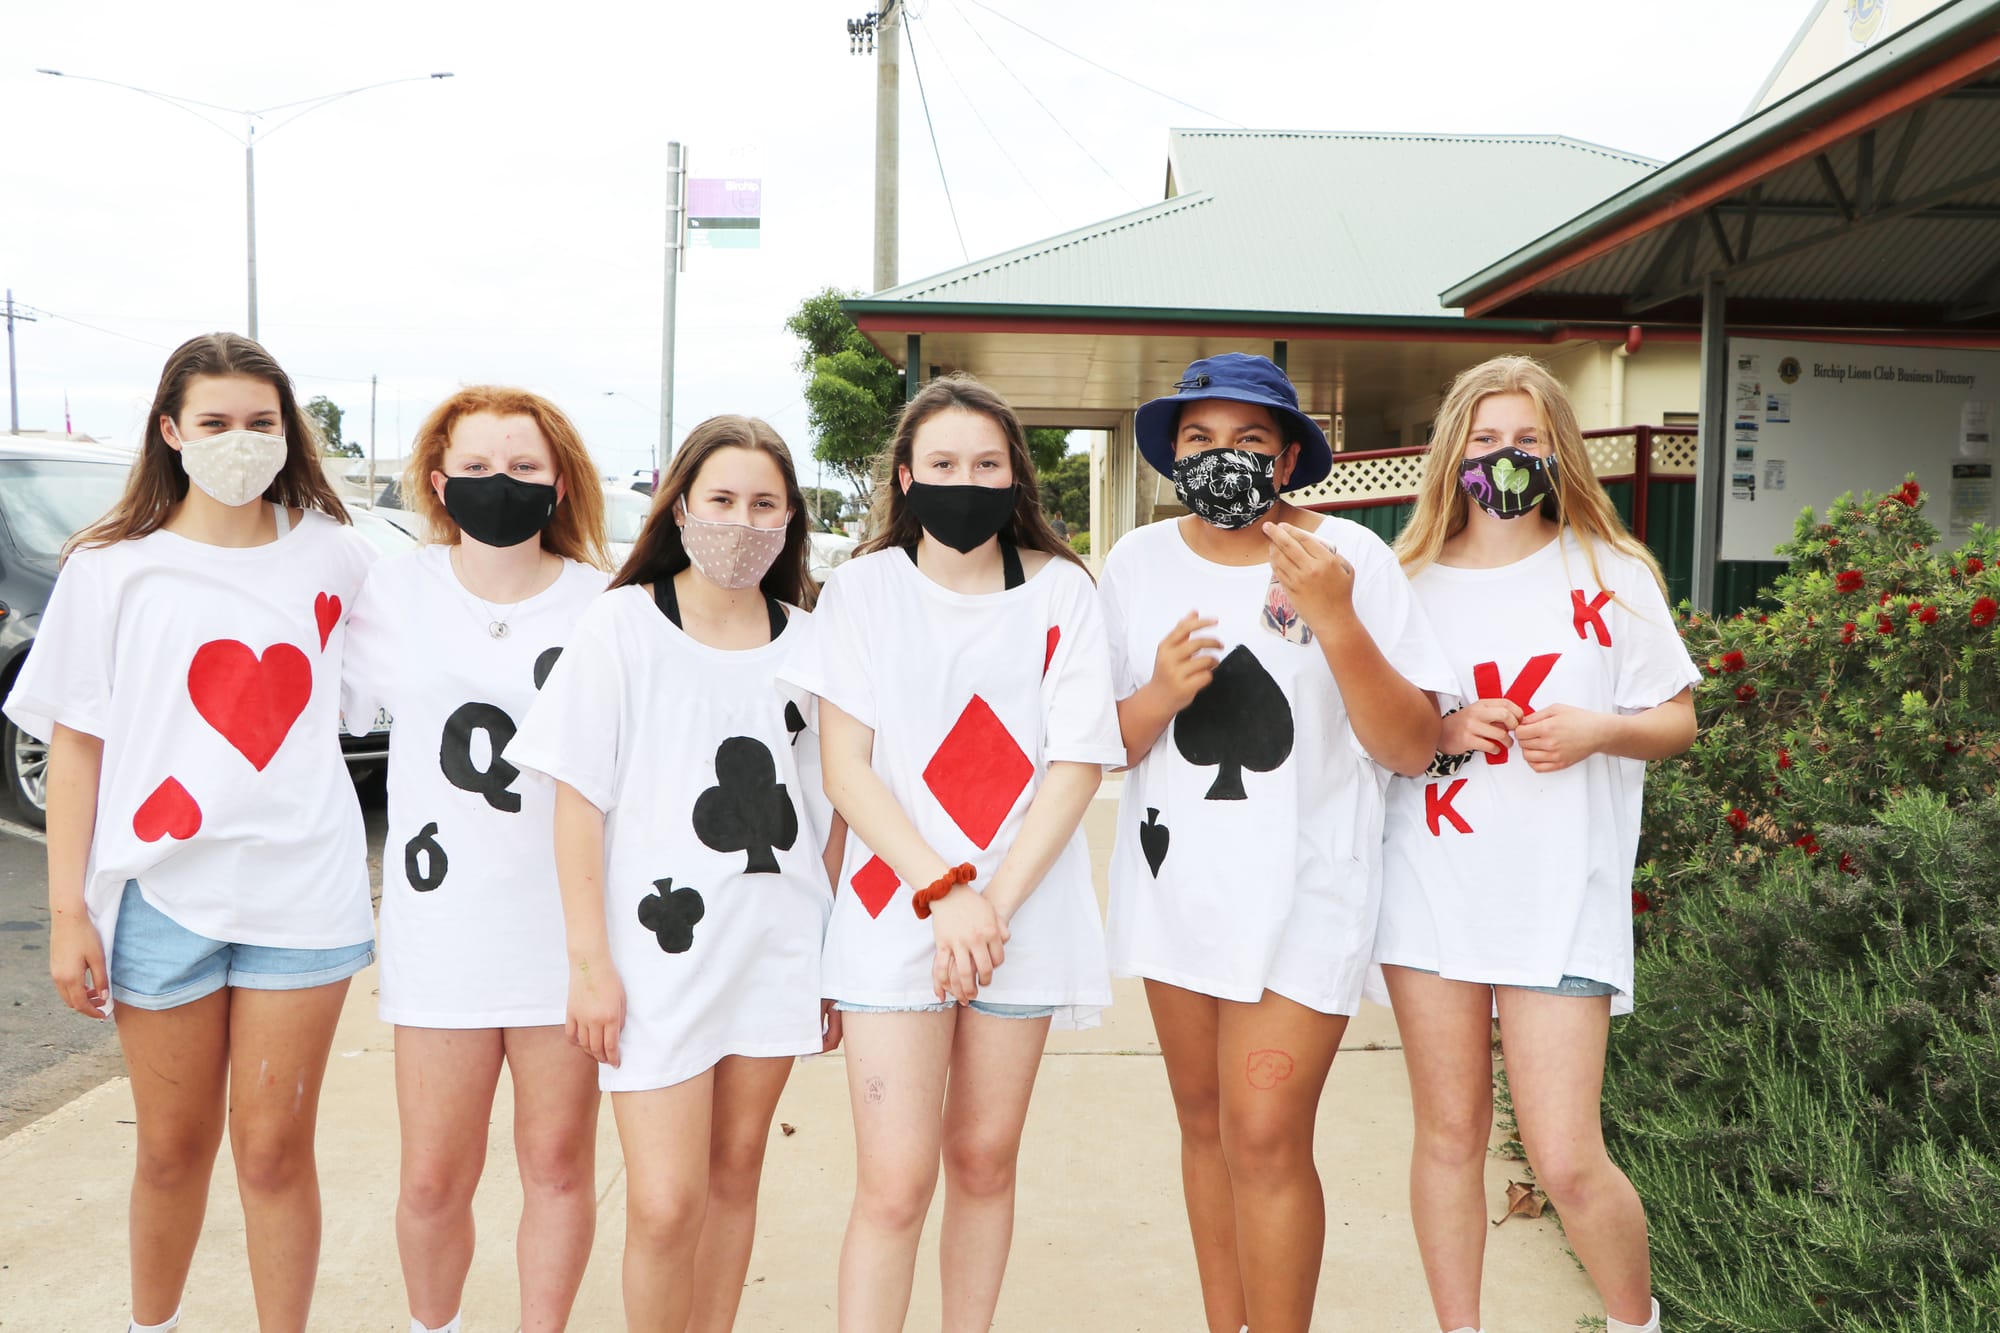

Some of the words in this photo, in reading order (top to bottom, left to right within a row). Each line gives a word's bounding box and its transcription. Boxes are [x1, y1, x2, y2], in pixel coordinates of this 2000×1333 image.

[1813, 363, 1846, 383] Birchip
[1847, 364, 1872, 379] Lions
[1873, 365, 1895, 381] Club
[1897, 367, 1934, 383] Business
[1935, 369, 1976, 389] Directory
[1570, 588, 1615, 647] K
[1473, 652, 1562, 765] K
[440, 701, 522, 814] Q
[1425, 777, 1475, 837] K
